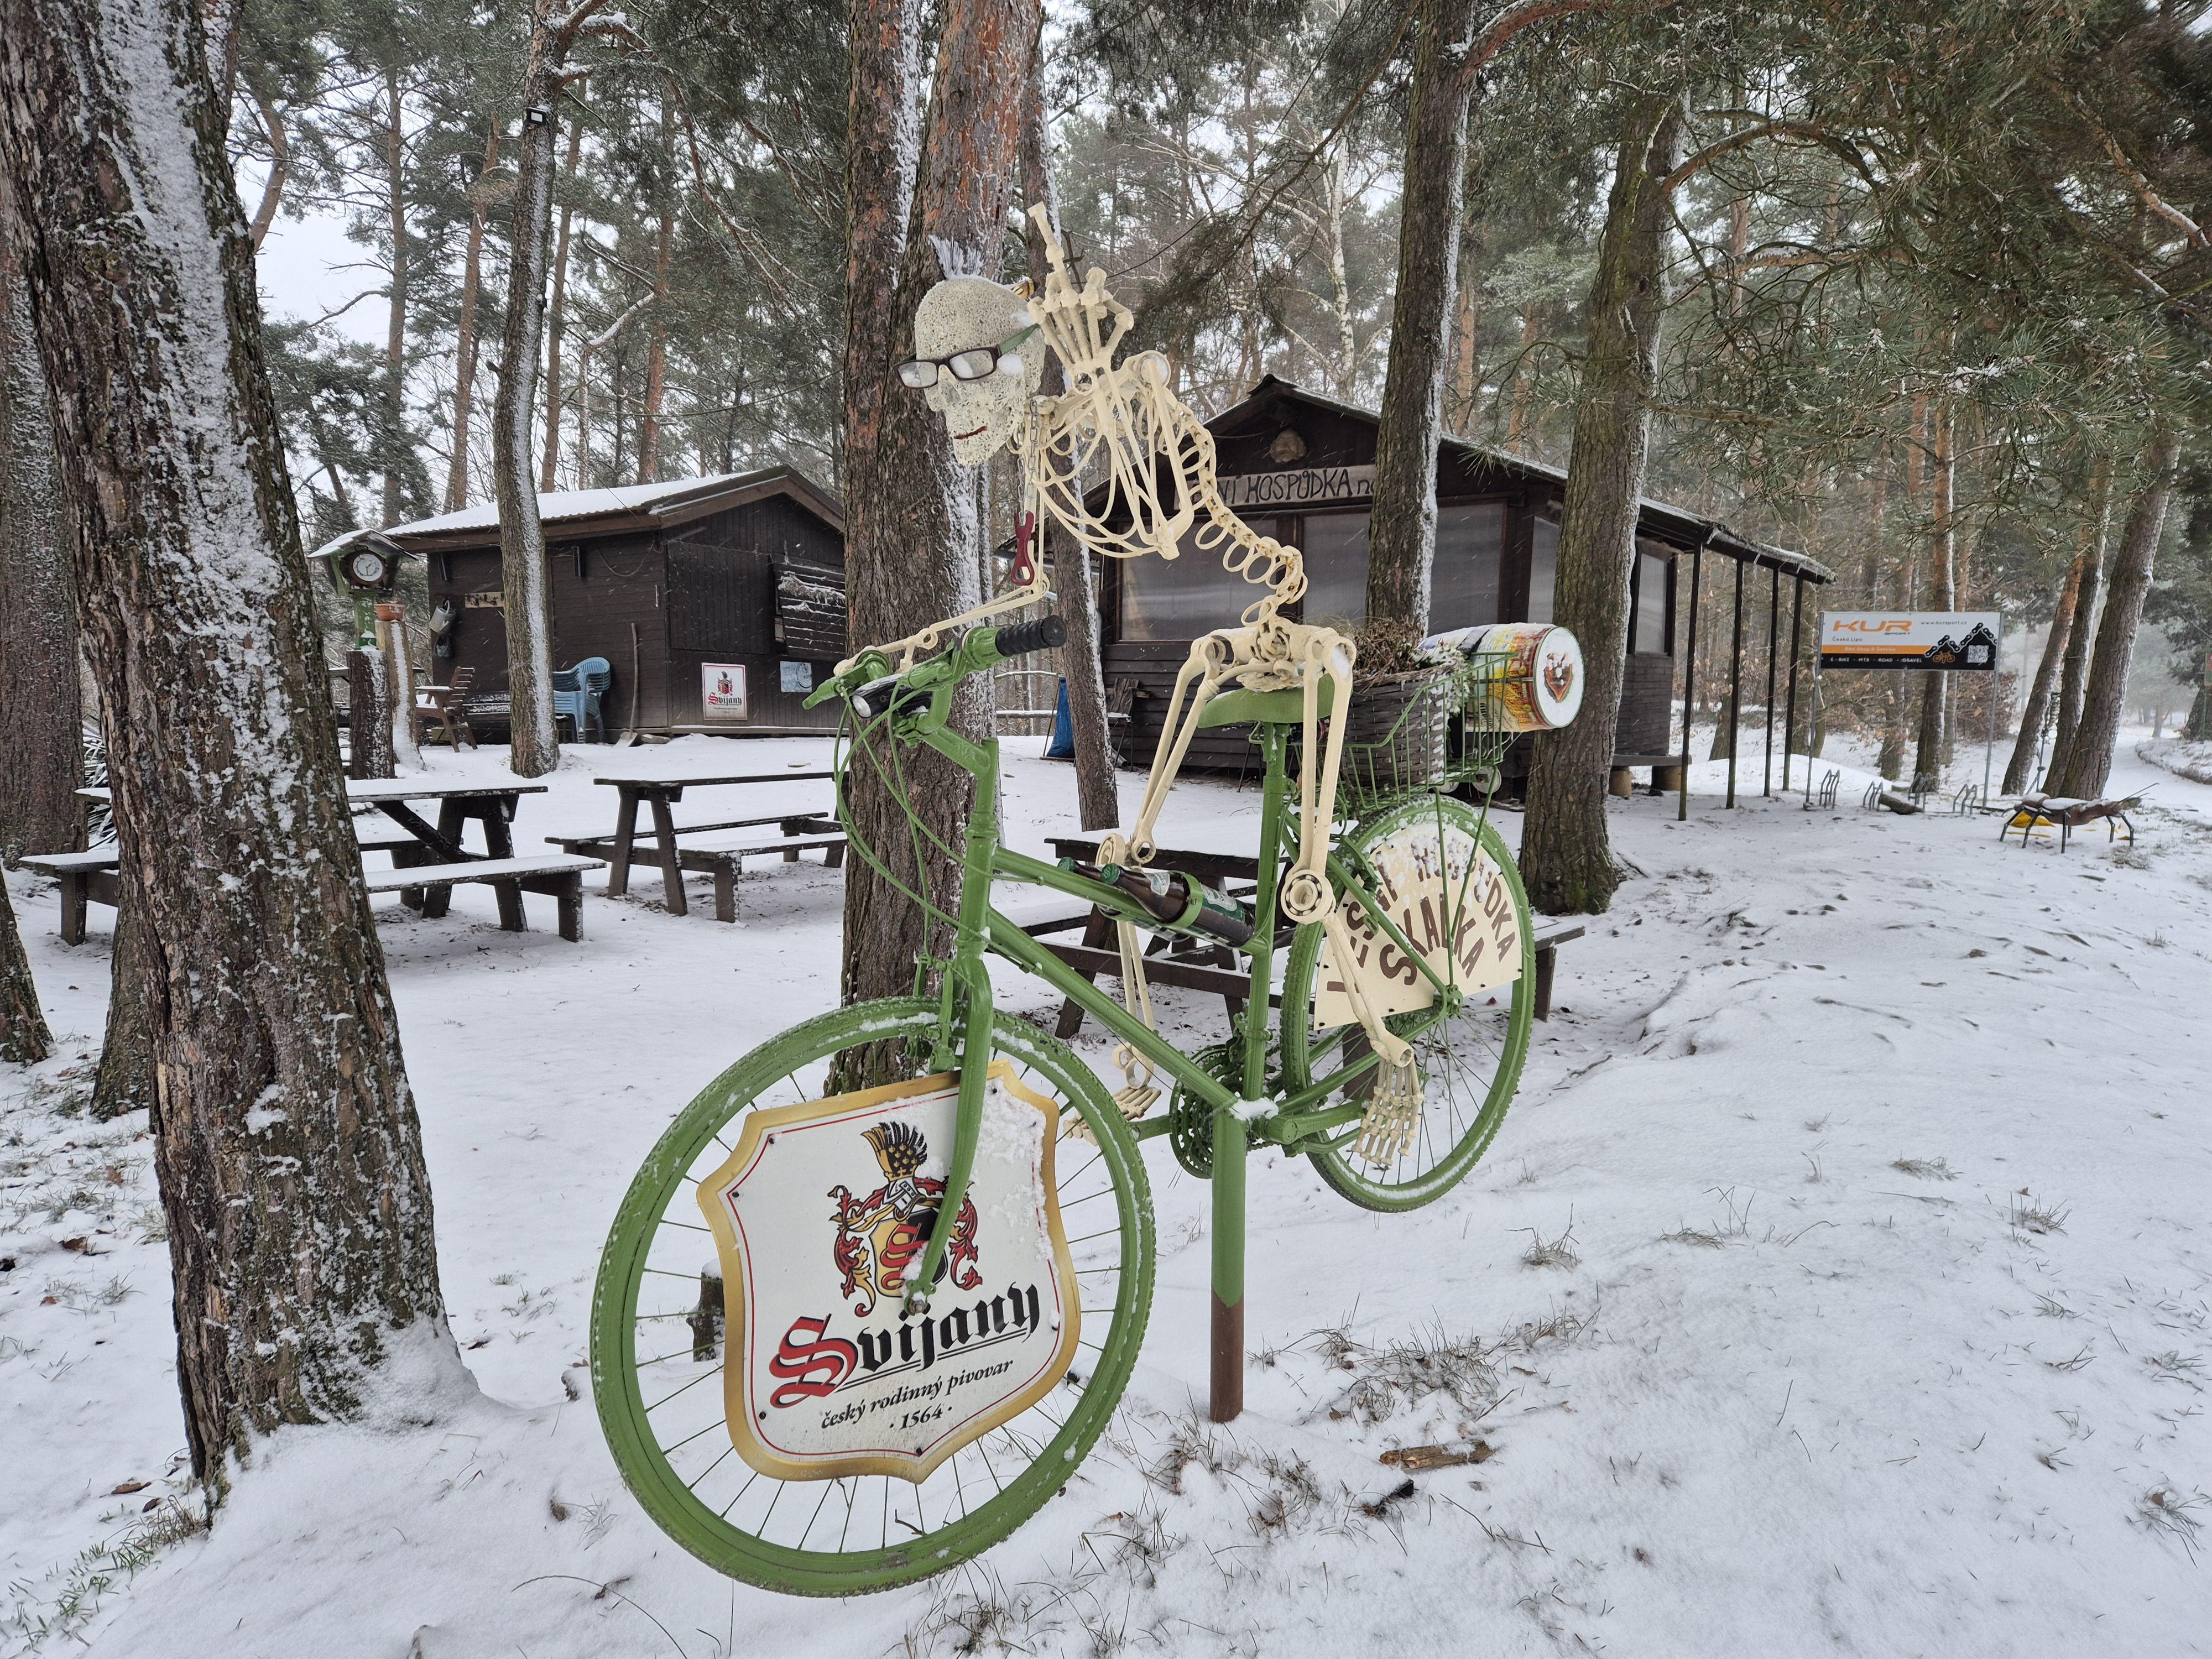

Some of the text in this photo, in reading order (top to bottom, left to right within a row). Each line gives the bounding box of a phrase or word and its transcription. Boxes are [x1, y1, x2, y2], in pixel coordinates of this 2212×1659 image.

[1245, 469, 1353, 503] HOSPŮDKA
[1833, 620, 1912, 632] KUR
[708, 692, 742, 706] Svijany
[769, 1281, 1040, 1408] Svijany
[821, 1359, 1014, 1430] český rodinný pivovar
[899, 1405, 944, 1430] 1564
